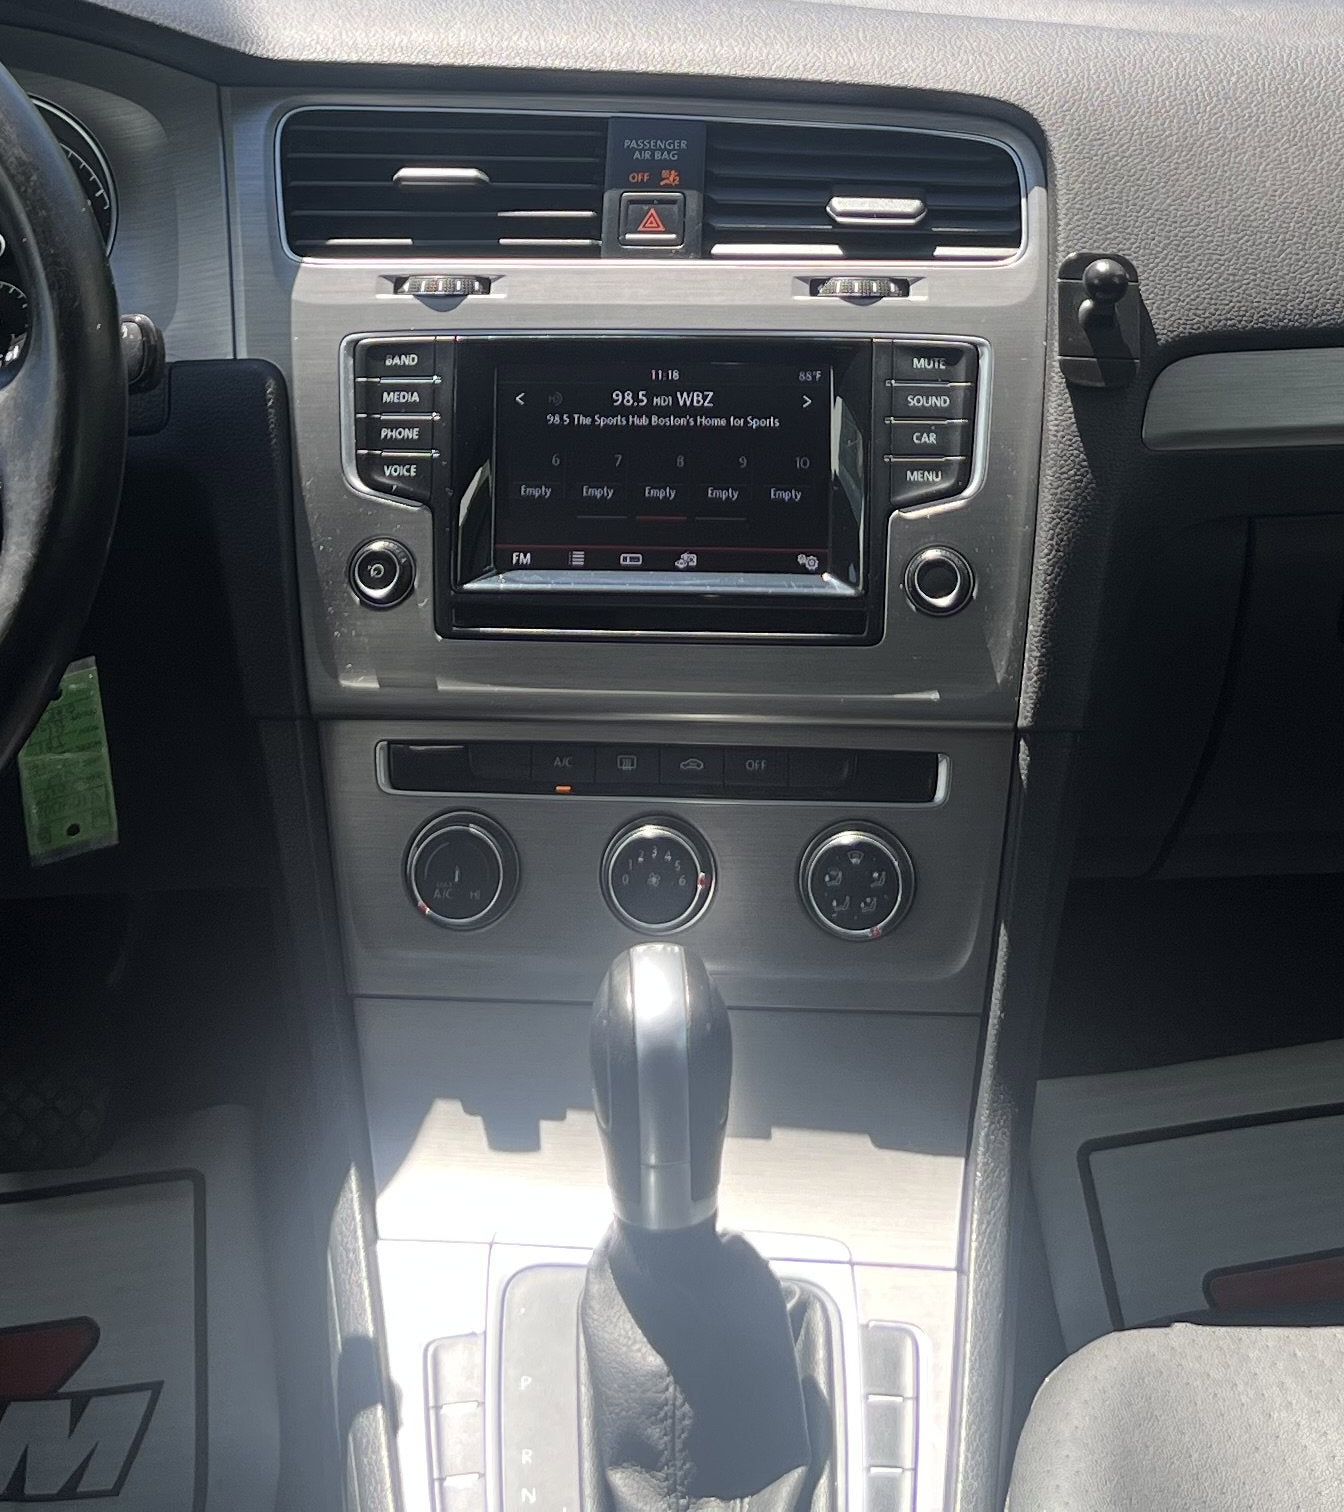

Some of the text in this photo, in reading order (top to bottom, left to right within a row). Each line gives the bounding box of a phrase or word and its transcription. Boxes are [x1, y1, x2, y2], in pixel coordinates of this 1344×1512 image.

[624, 139, 687, 149] PASSENGER
[633, 150, 678, 160] AIR BAG
[629, 171, 651, 182] OFF
[385, 354, 418, 366] BAND
[913, 357, 946, 369] MUTE
[650, 369, 680, 381] 11:18
[799, 370, 822, 382] 88°F
[382, 391, 420, 403] MEDIA
[612, 391, 715, 407] 98.5 HD1 WBZ
[907, 395, 950, 407] SOUND
[573, 414, 592, 426] The
[594, 414, 627, 428] Sports
[629, 414, 650, 426] Hub
[651, 414, 695, 427] Boston's
[697, 414, 727, 427] Home
[730, 415, 744, 427] for
[746, 415, 780, 429] Sports
[381, 428, 419, 440] PHONE
[913, 432, 937, 444] CAR
[551, 454, 560, 466] 6
[613, 454, 623, 467] 7
[676, 455, 685, 468] 8
[739, 456, 748, 469] 9
[795, 456, 810, 469] 10
[384, 465, 417, 477] VOICE
[906, 470, 942, 482] MENU
[520, 485, 552, 498] Empty
[582, 486, 614, 499] Empty
[644, 486, 676, 500] Empty
[707, 487, 739, 501] Empty
[770, 488, 802, 501] Empty
[512, 552, 531, 565] FM
[553, 756, 574, 768] A/C
[745, 760, 768, 771] OFF
[674, 860, 681, 872] 5
[621, 874, 629, 885] 0
[678, 875, 686, 886] 6
[433, 888, 453, 900] A/C
[520, 1375, 532, 1390] P
[521, 1448, 533, 1464] R
[521, 1488, 536, 1503] N
